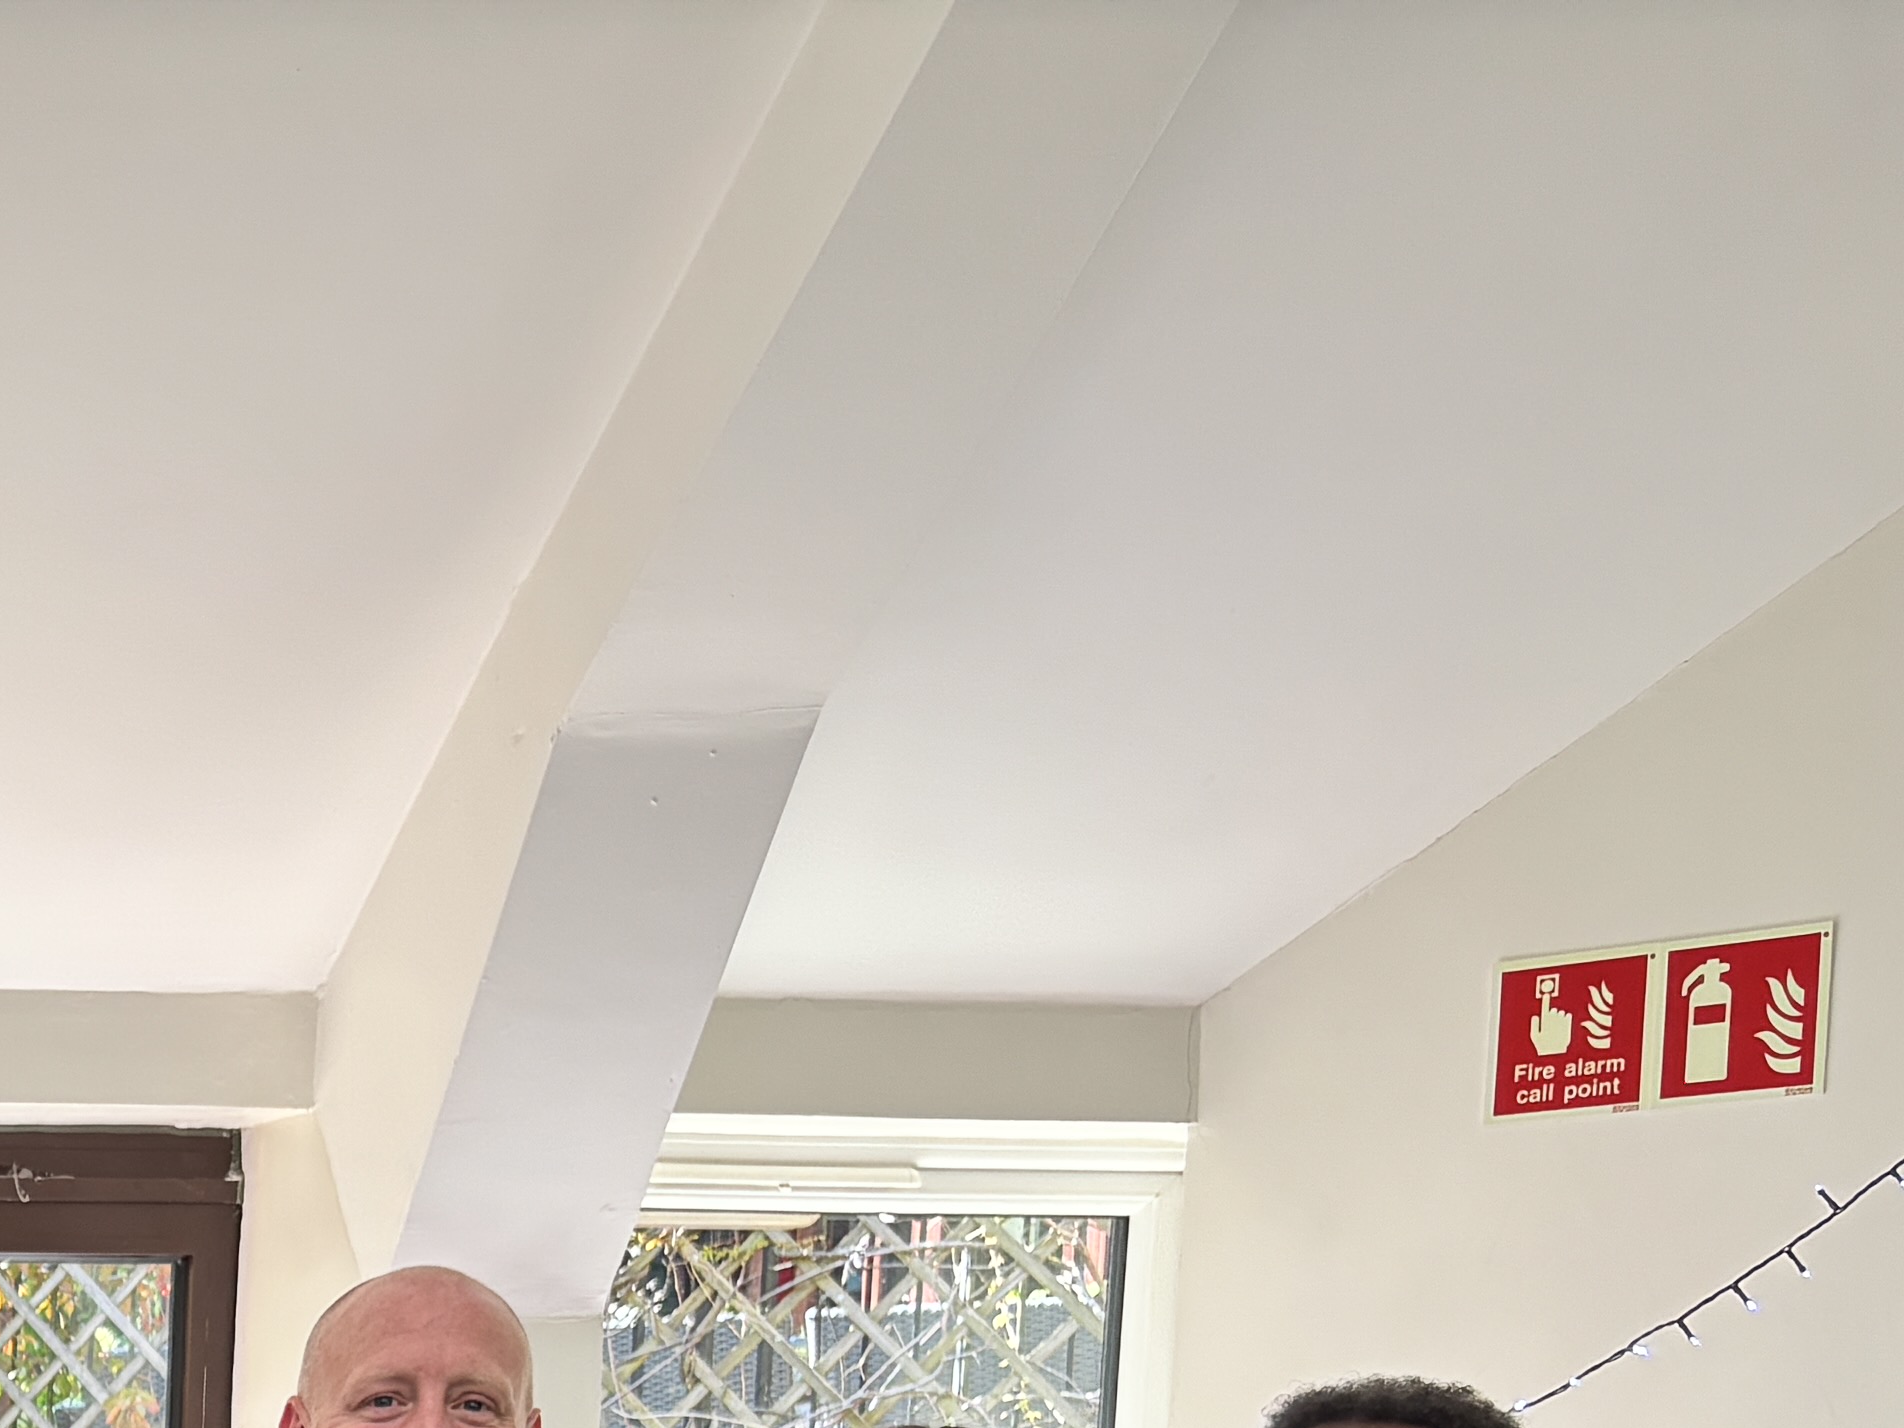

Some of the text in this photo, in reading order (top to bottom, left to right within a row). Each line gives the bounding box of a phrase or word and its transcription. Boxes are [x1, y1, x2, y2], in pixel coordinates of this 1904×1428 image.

[1514, 1057, 1625, 1083] Fire alarm
[1516, 1077, 1620, 1105] call point
